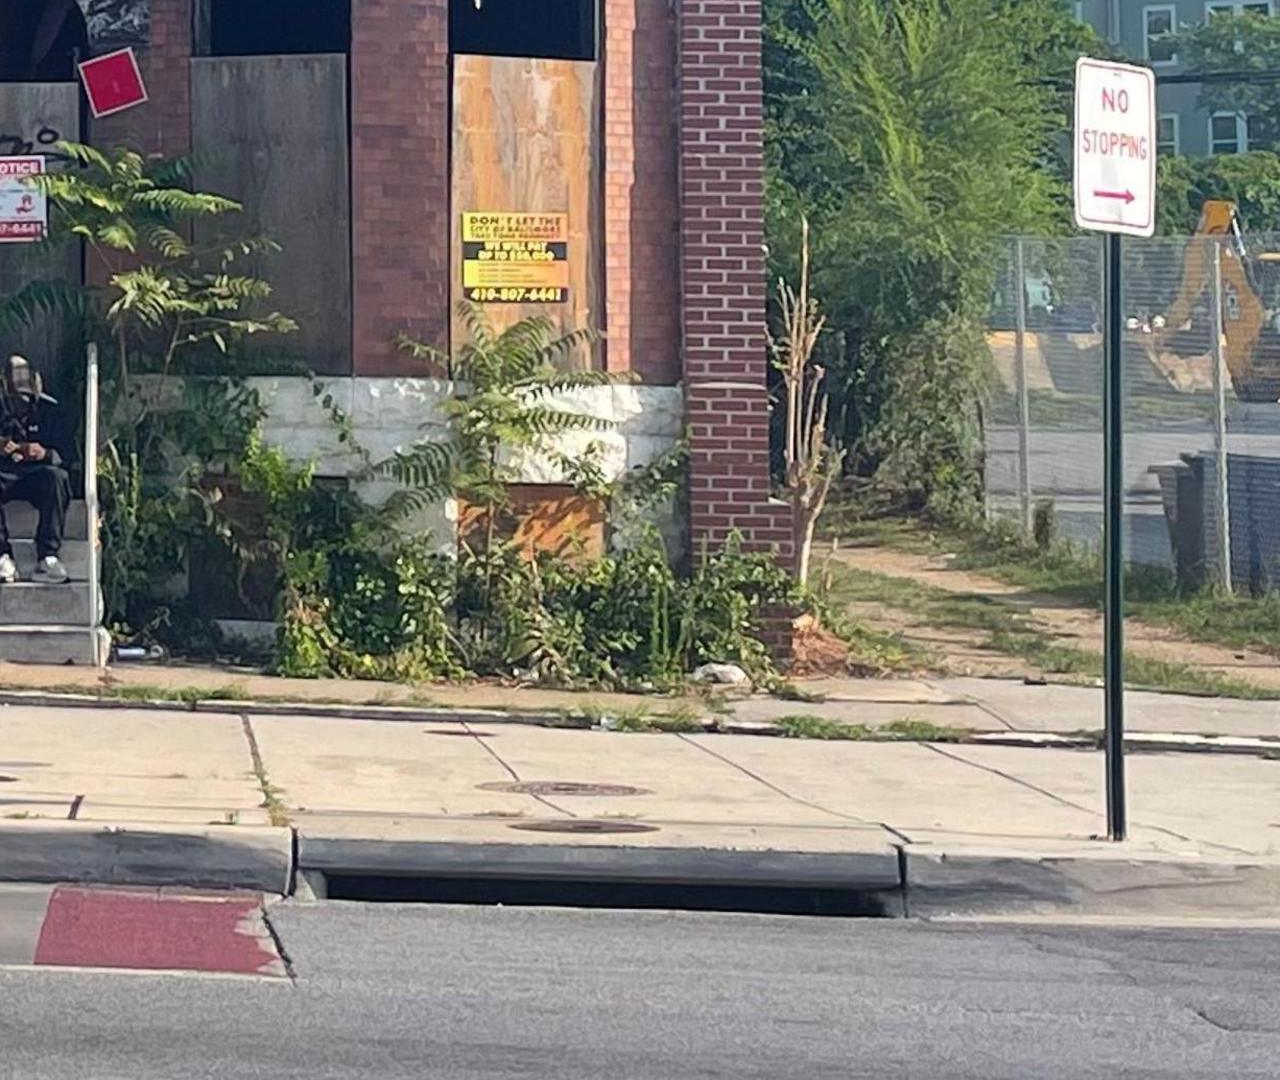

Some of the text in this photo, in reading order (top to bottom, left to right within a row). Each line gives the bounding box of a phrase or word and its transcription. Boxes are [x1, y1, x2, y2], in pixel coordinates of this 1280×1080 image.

[1102, 88, 1129, 114] NO
[1083, 128, 1147, 161] STOPPING
[516, 216, 535, 225] LET
[538, 216, 561, 226] THE
